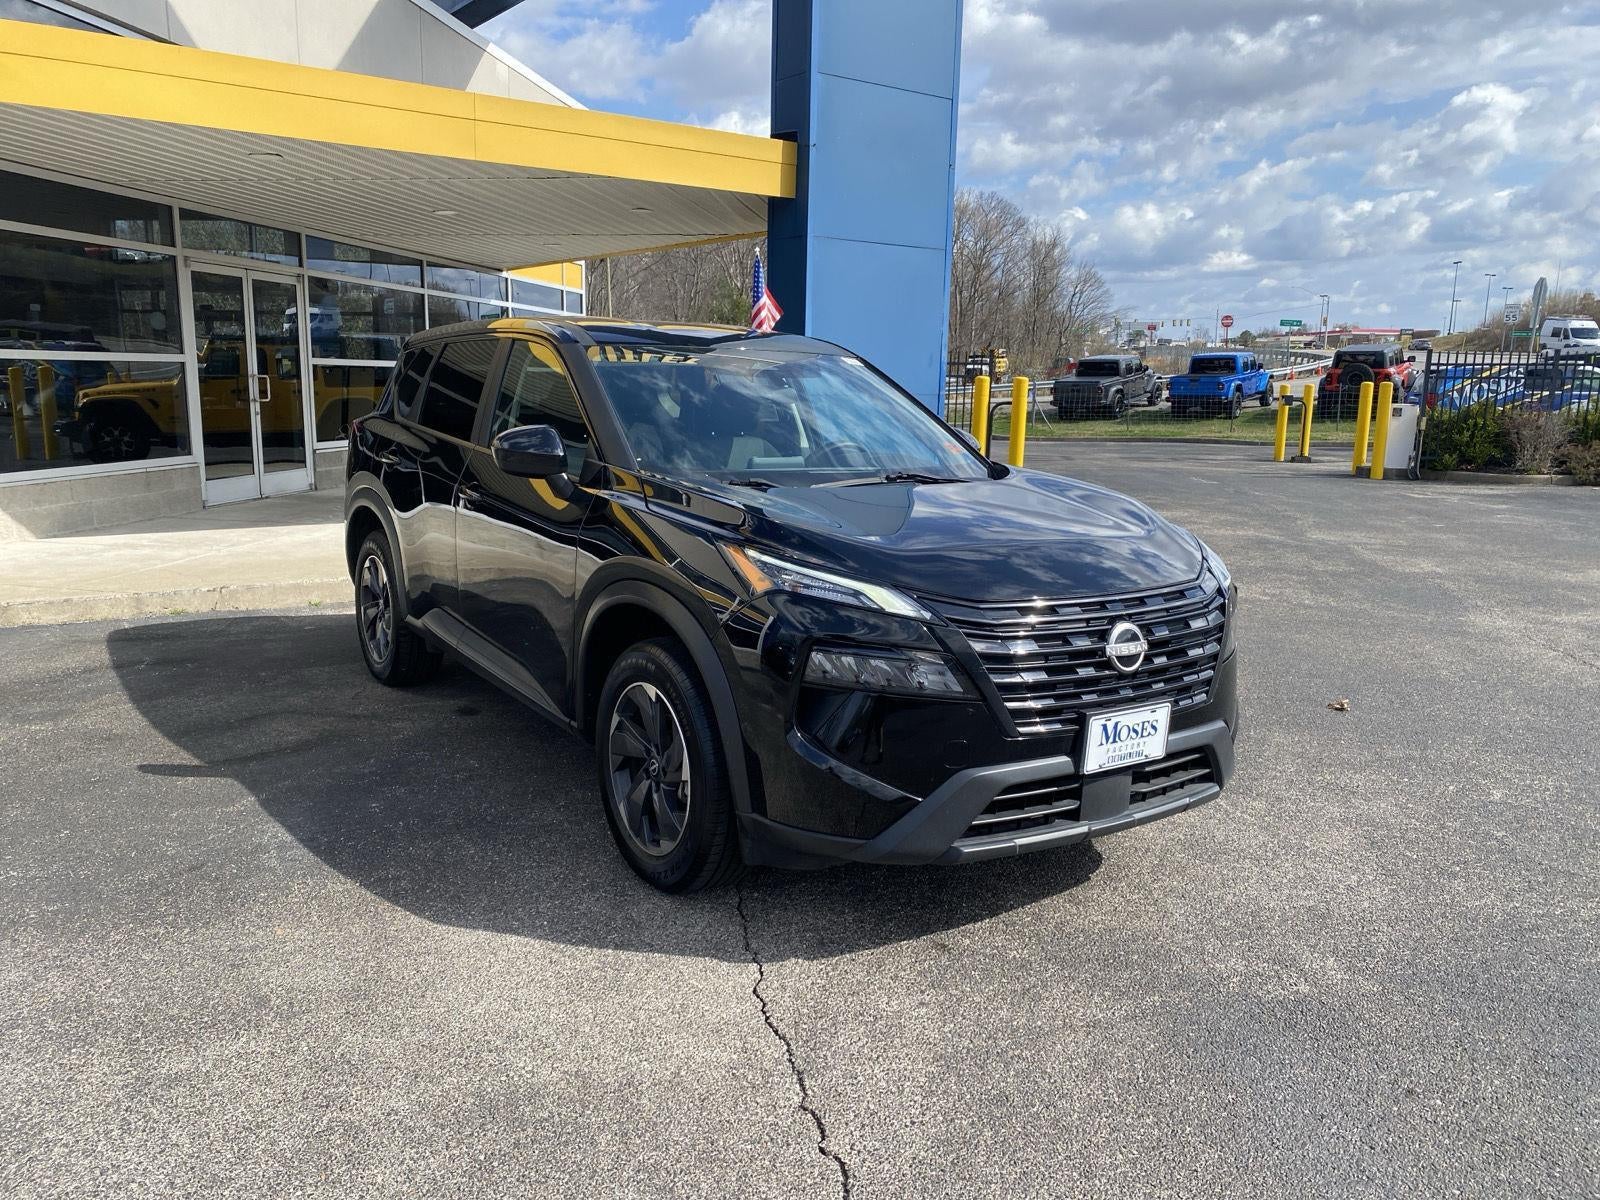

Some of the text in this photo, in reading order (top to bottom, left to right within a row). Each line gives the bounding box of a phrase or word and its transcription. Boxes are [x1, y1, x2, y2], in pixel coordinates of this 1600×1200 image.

[1505, 314, 1518, 322] 55
[1106, 640, 1148, 656] NISSAN
[1098, 719, 1159, 747] MOSES
[1106, 740, 1147, 754] FACTORY
